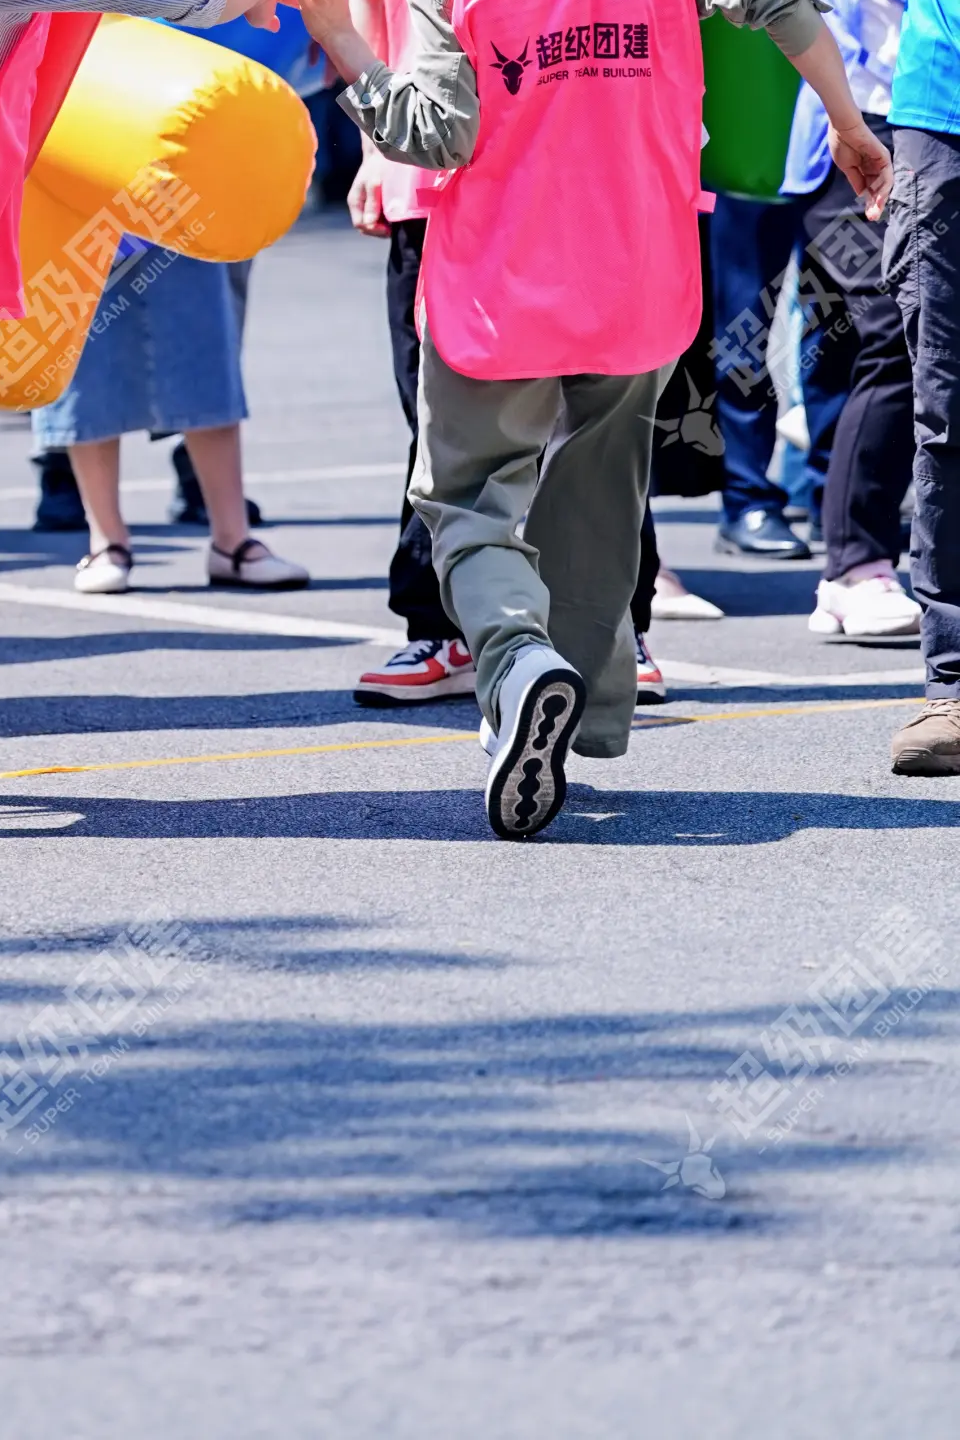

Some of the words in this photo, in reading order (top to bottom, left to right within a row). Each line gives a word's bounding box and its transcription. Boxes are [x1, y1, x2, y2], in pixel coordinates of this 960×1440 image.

[536, 22, 649, 71] 超级团建
[537, 70, 569, 86] SUPER
[574, 66, 599, 78] TEAM
[602, 67, 652, 78] BUILDING
